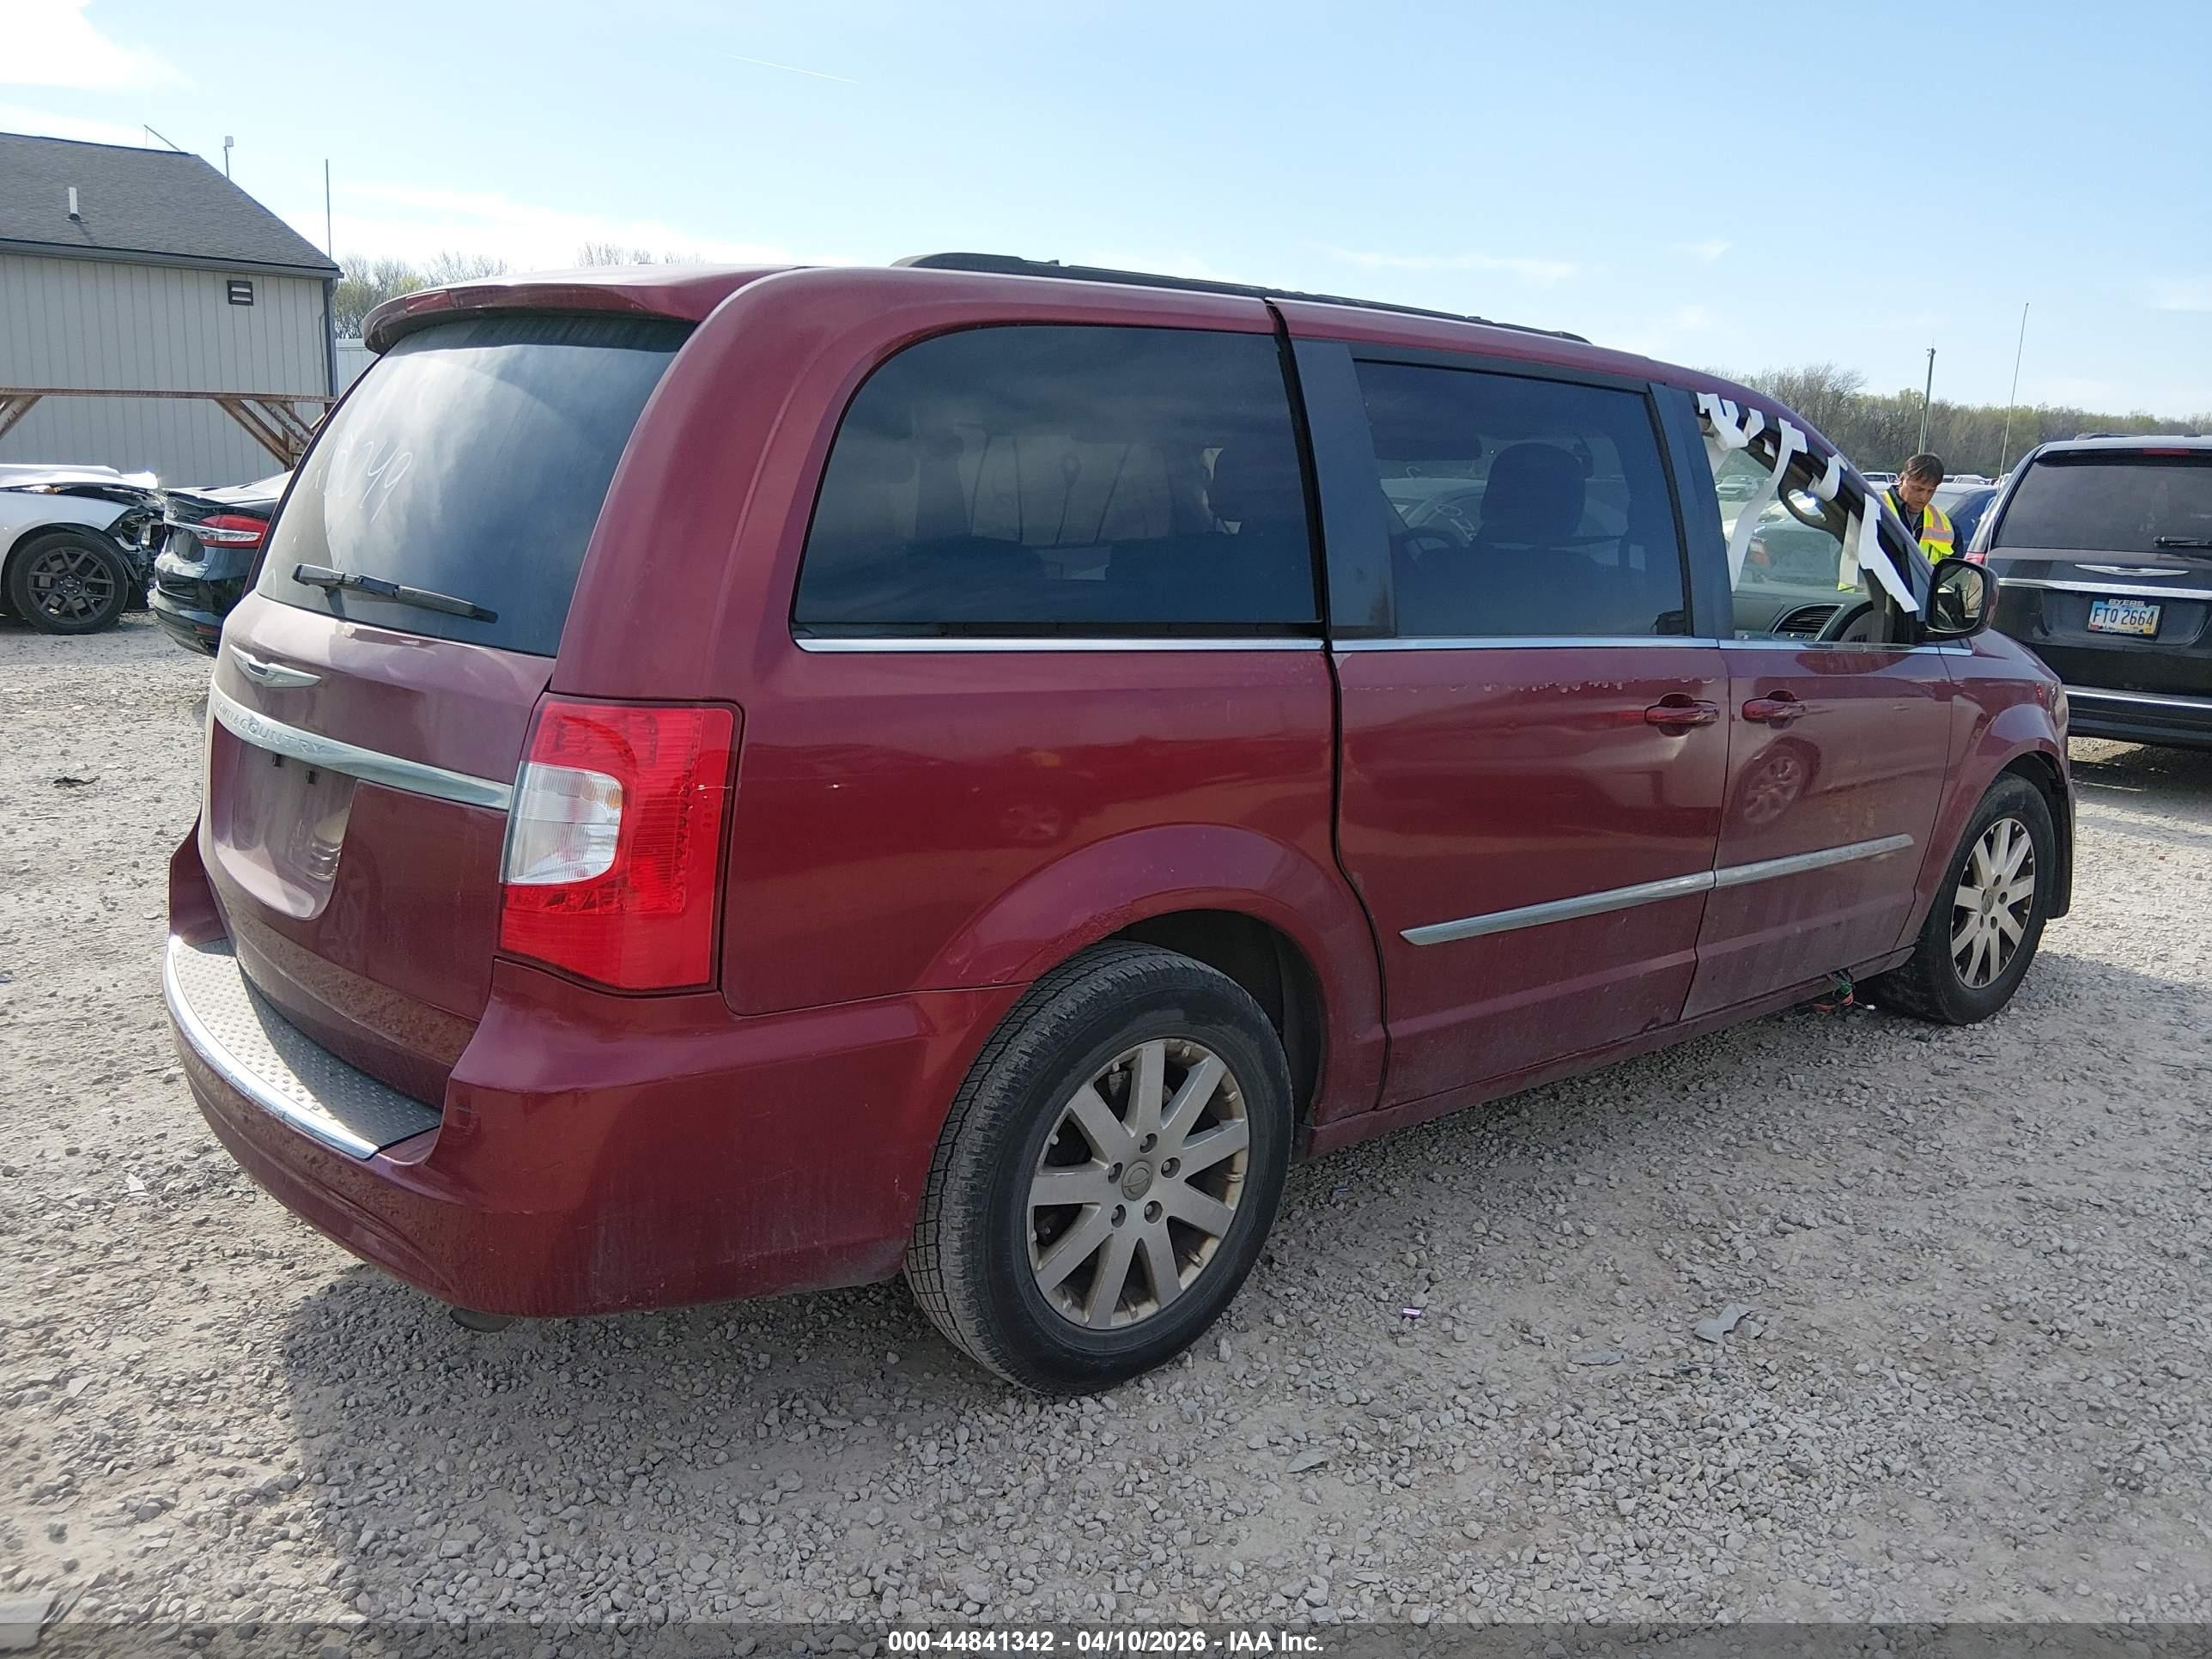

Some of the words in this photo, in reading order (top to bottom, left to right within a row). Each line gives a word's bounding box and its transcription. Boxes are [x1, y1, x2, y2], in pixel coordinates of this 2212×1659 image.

[2108, 599, 2145, 607] BYERS
[2121, 610, 2154, 627] 2664
[240, 718, 326, 754] COUNTRY
